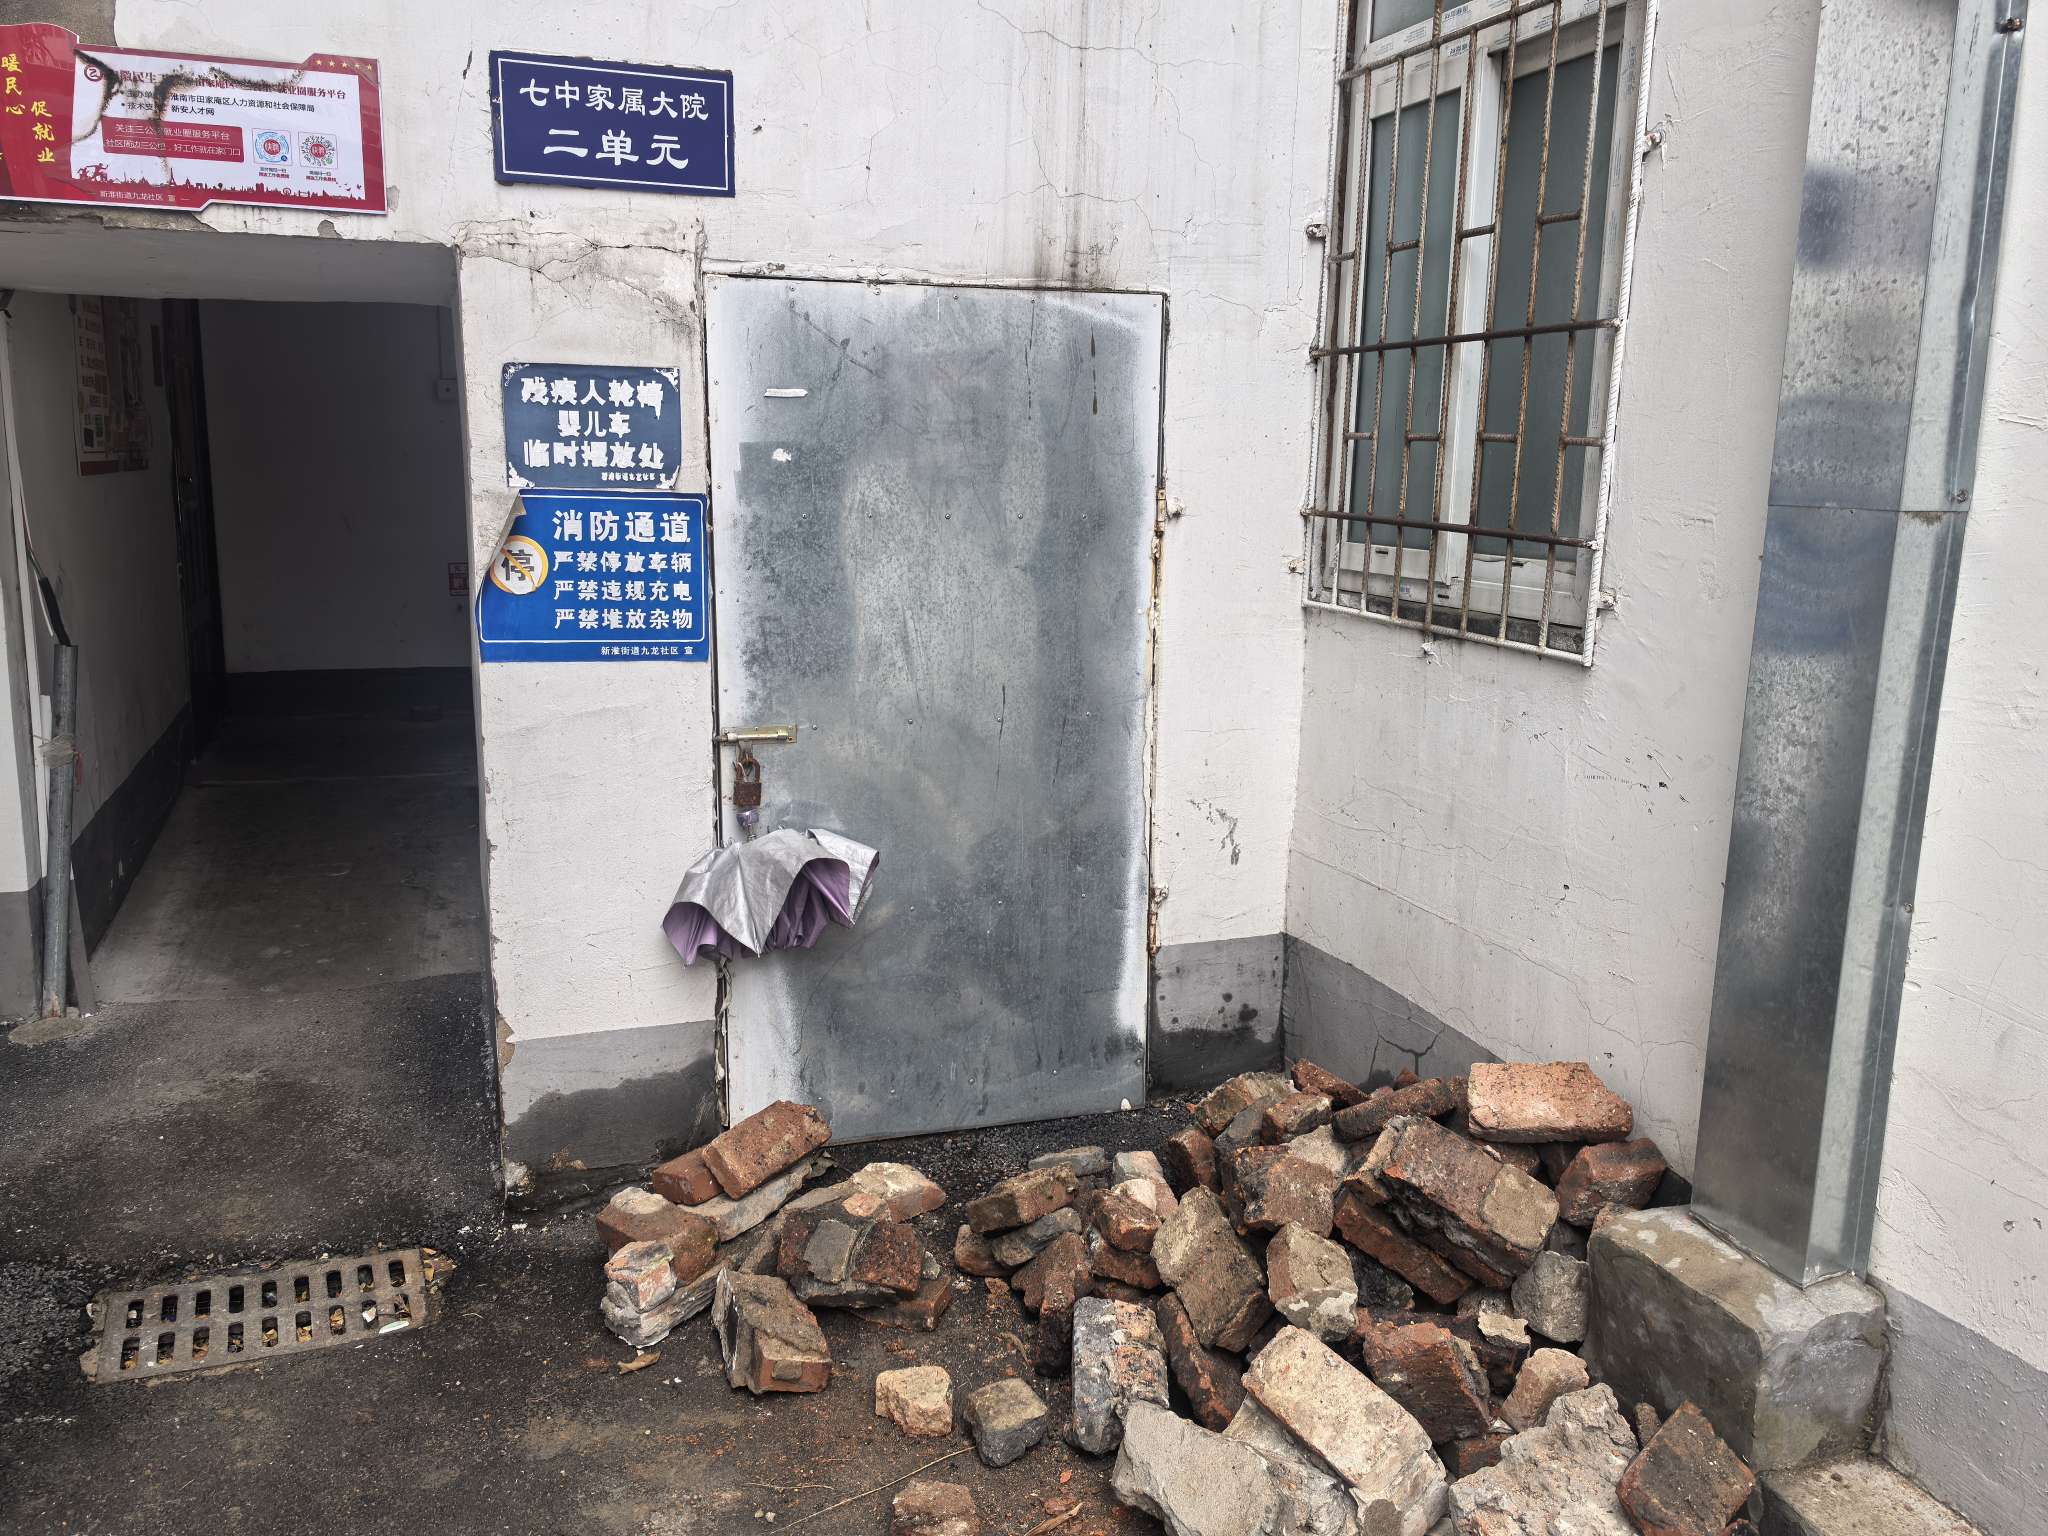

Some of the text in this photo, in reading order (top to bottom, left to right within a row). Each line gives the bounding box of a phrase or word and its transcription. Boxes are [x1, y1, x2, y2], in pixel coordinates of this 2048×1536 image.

[1, 53, 26, 115] 暖民心
[519, 78, 709, 121] 七中家属大院
[31, 101, 55, 162] 促就业
[543, 128, 689, 170] 二单元
[557, 409, 631, 438] 婴儿车
[523, 439, 664, 469] 临时摆放处
[551, 509, 691, 543] 消防通道
[552, 550, 692, 573] 严禁停放车辆
[553, 579, 693, 601] 严禁违规充电
[554, 608, 693, 630] 严禁堆放杂物
[600, 645, 694, 656] 新淮街道九龙社区 宣
